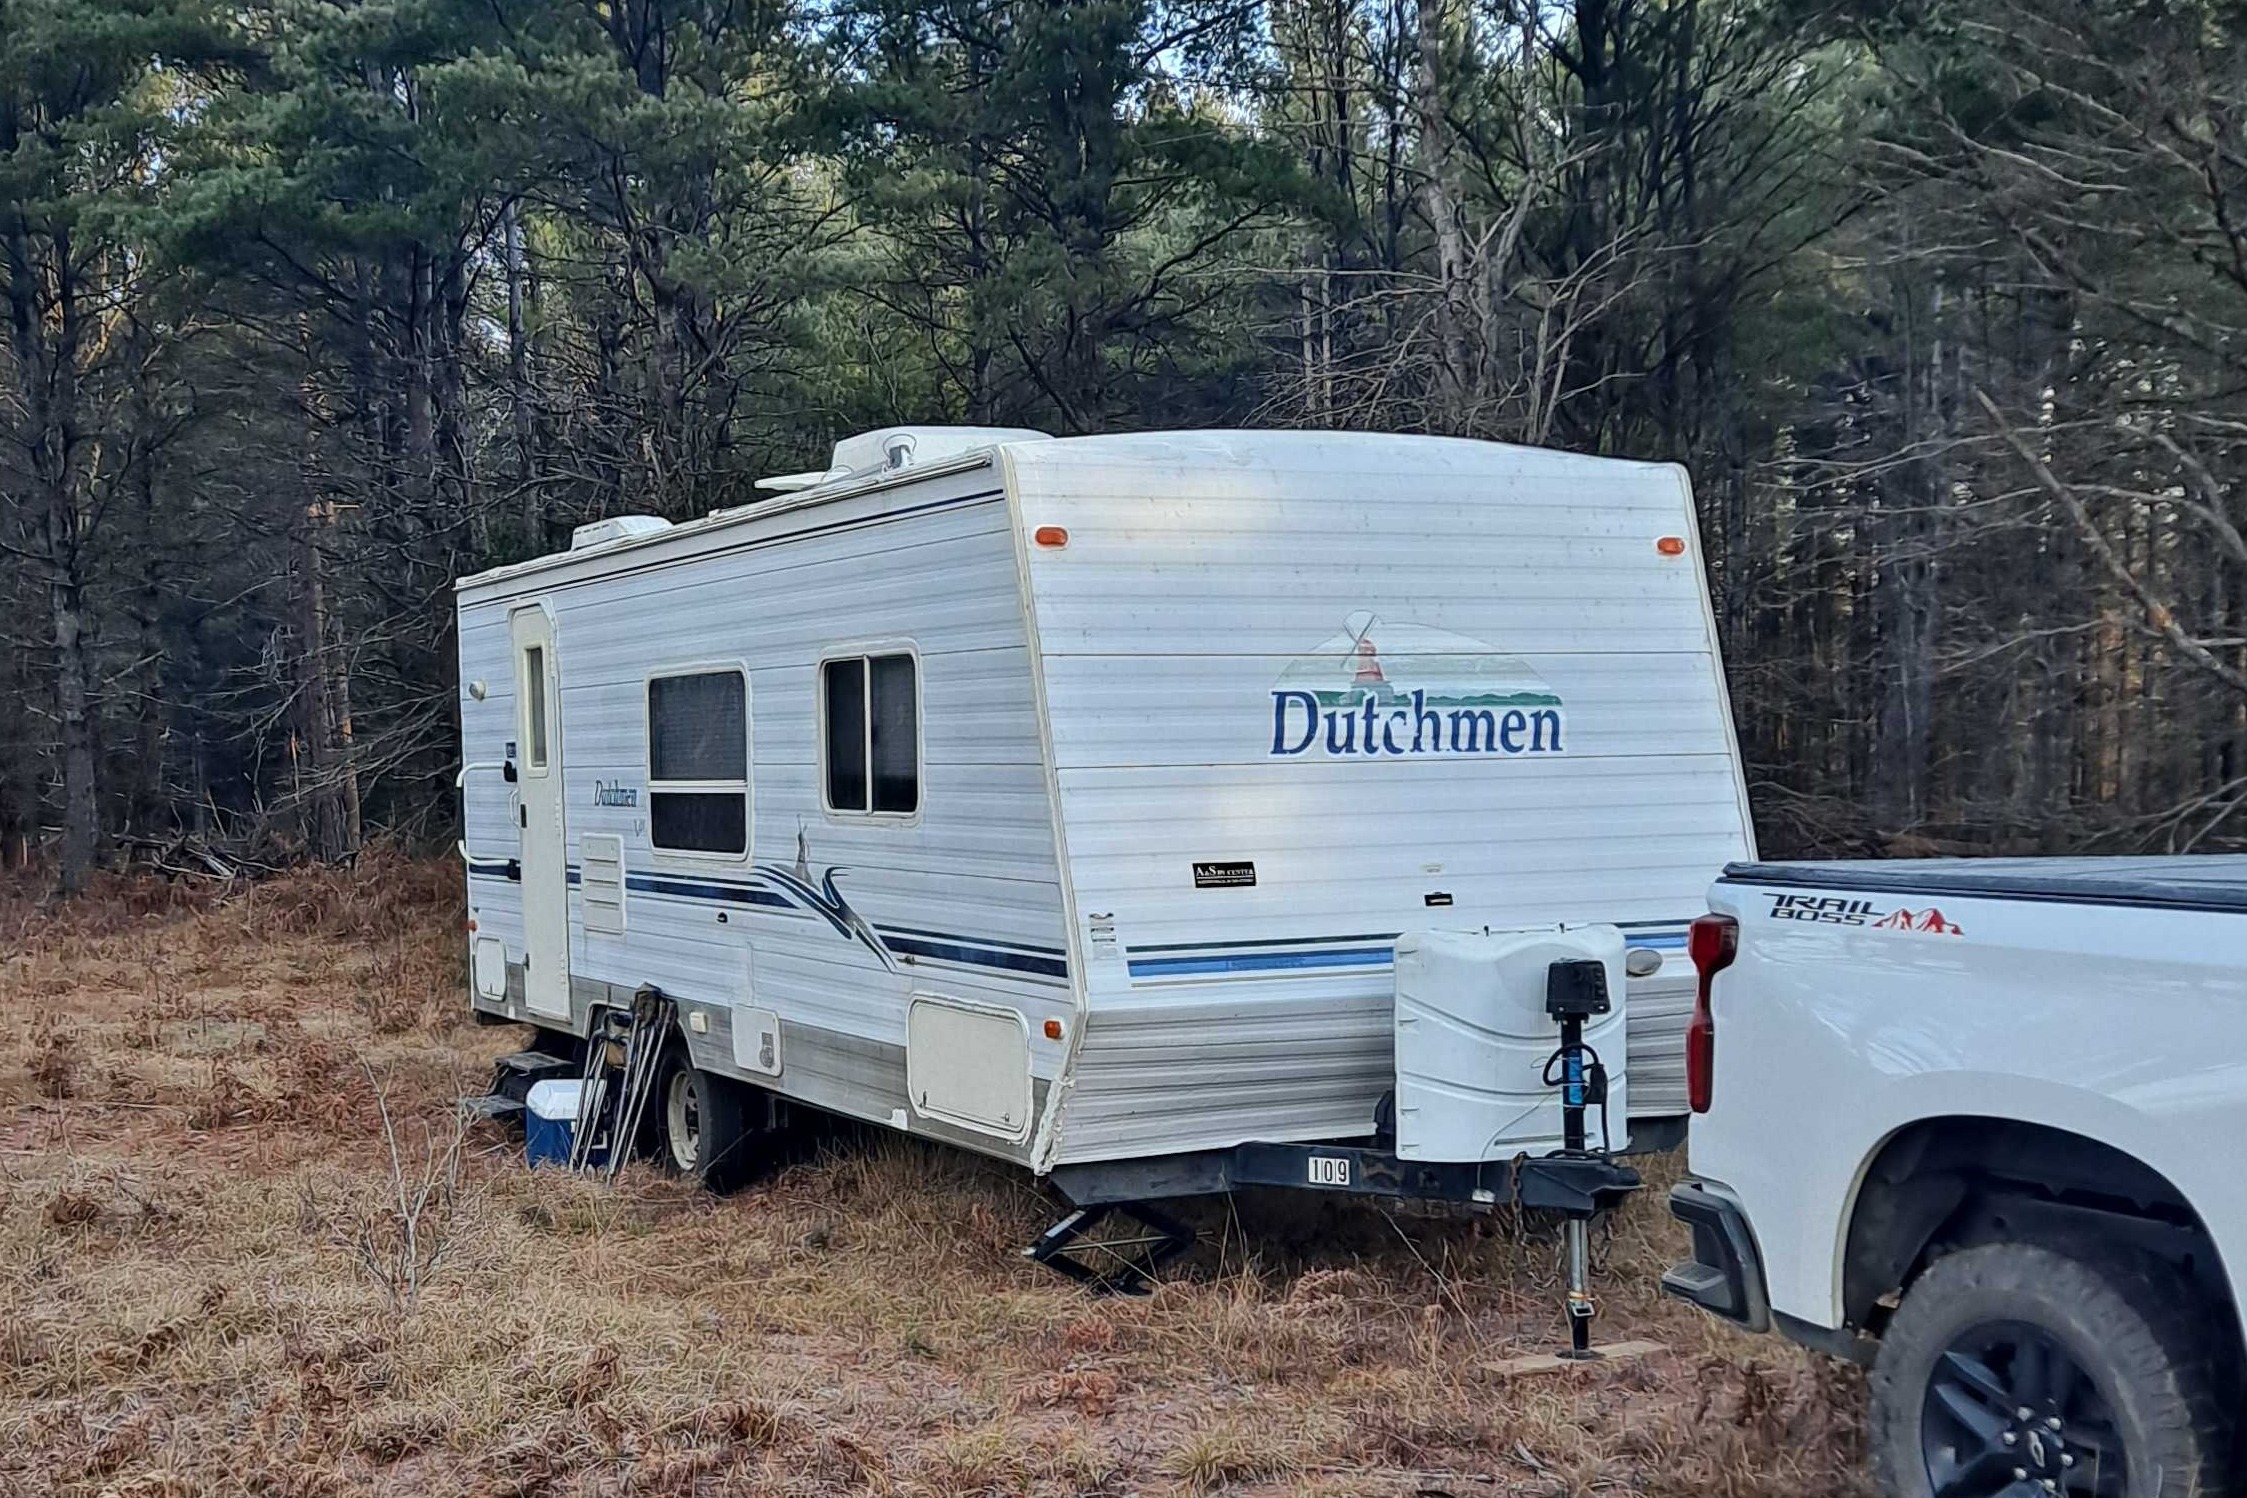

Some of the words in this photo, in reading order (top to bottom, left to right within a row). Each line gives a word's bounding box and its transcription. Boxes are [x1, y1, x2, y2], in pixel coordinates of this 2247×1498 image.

[1269, 688, 1564, 755] Dutchmen
[1762, 892, 1886, 917] TRAIL
[1769, 907, 1869, 927] BOSS
[1314, 1159, 1347, 1183] 109
